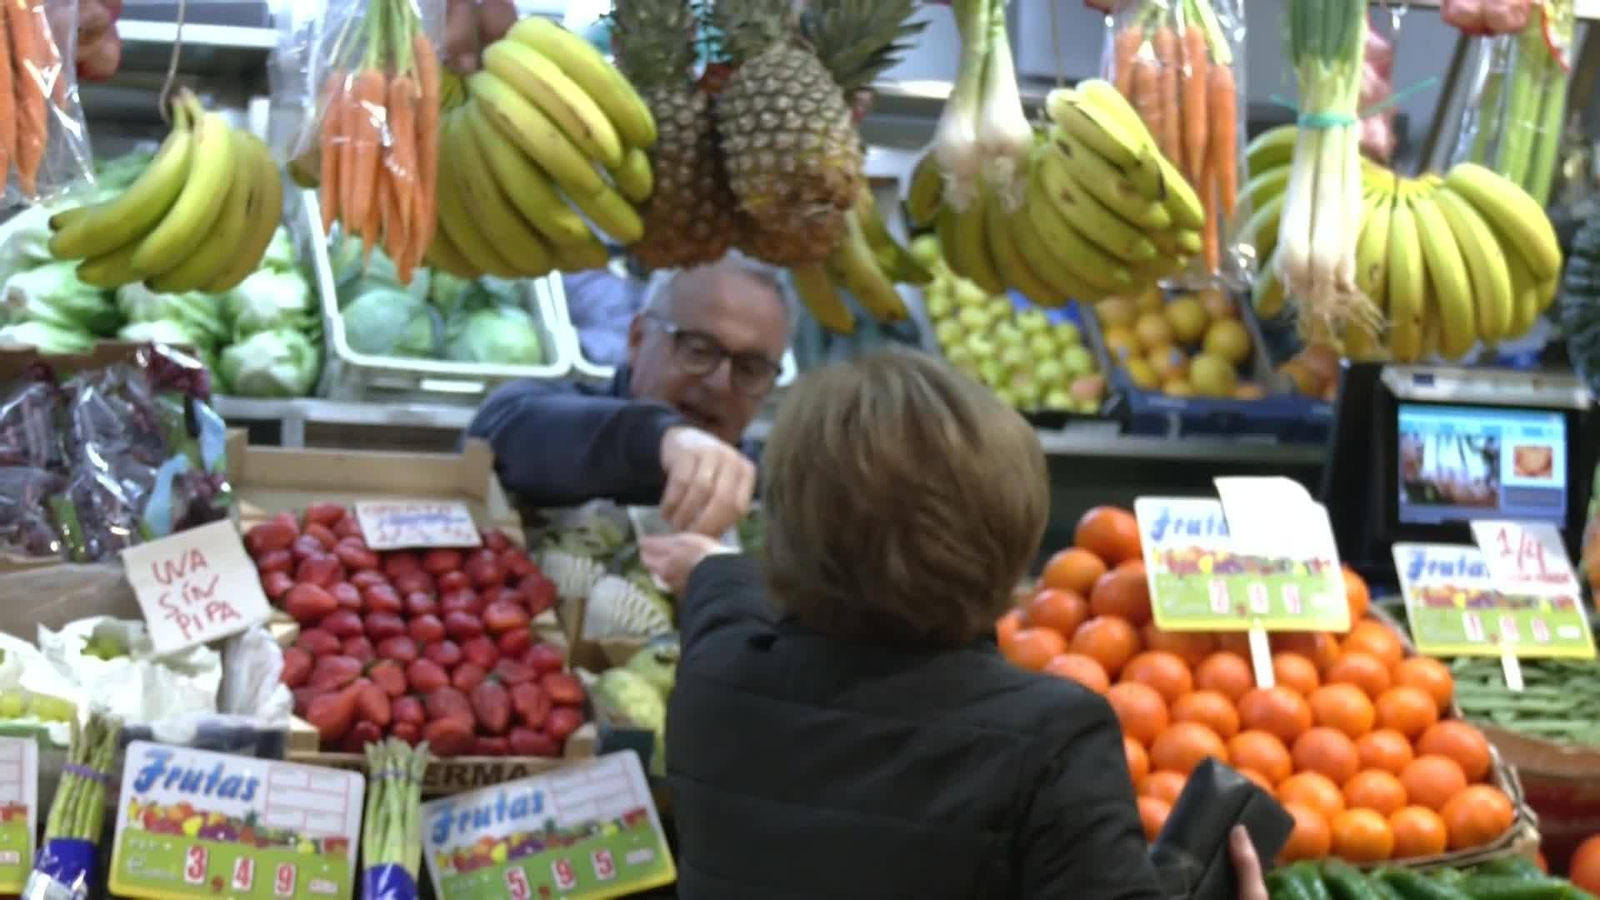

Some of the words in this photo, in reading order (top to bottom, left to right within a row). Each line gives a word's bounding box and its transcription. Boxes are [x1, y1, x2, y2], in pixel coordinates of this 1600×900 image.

[1151, 506, 1230, 542] Fruta
[152, 547, 208, 585] UVA
[1408, 546, 1486, 581] Fruta
[176, 600, 243, 640] PIPA
[133, 749, 261, 801] Frutas
[430, 787, 545, 845] Frutas
